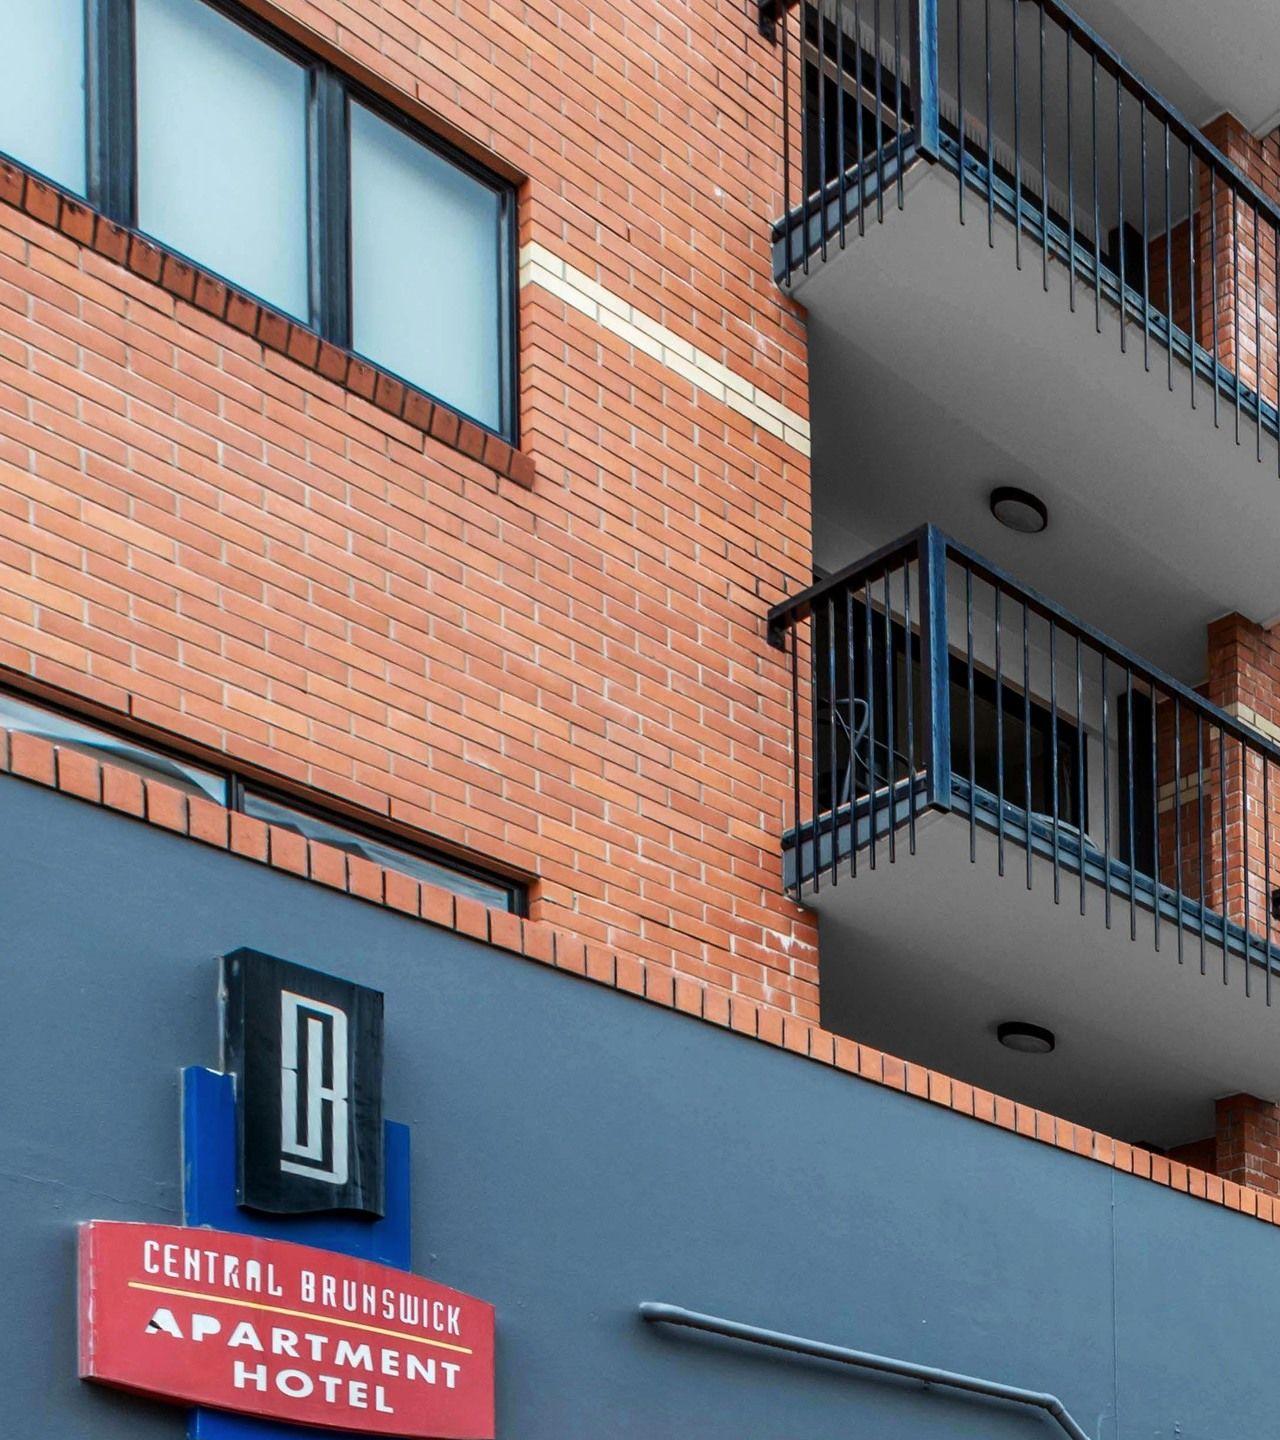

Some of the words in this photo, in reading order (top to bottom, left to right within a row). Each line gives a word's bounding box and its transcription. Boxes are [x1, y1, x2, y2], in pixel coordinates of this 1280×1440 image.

[144, 1240, 283, 1297] CENTRAL
[301, 1269, 461, 1336] BRUNSWICK
[145, 1307, 461, 1388] APARTMENT
[233, 1360, 394, 1414] HOTEL
